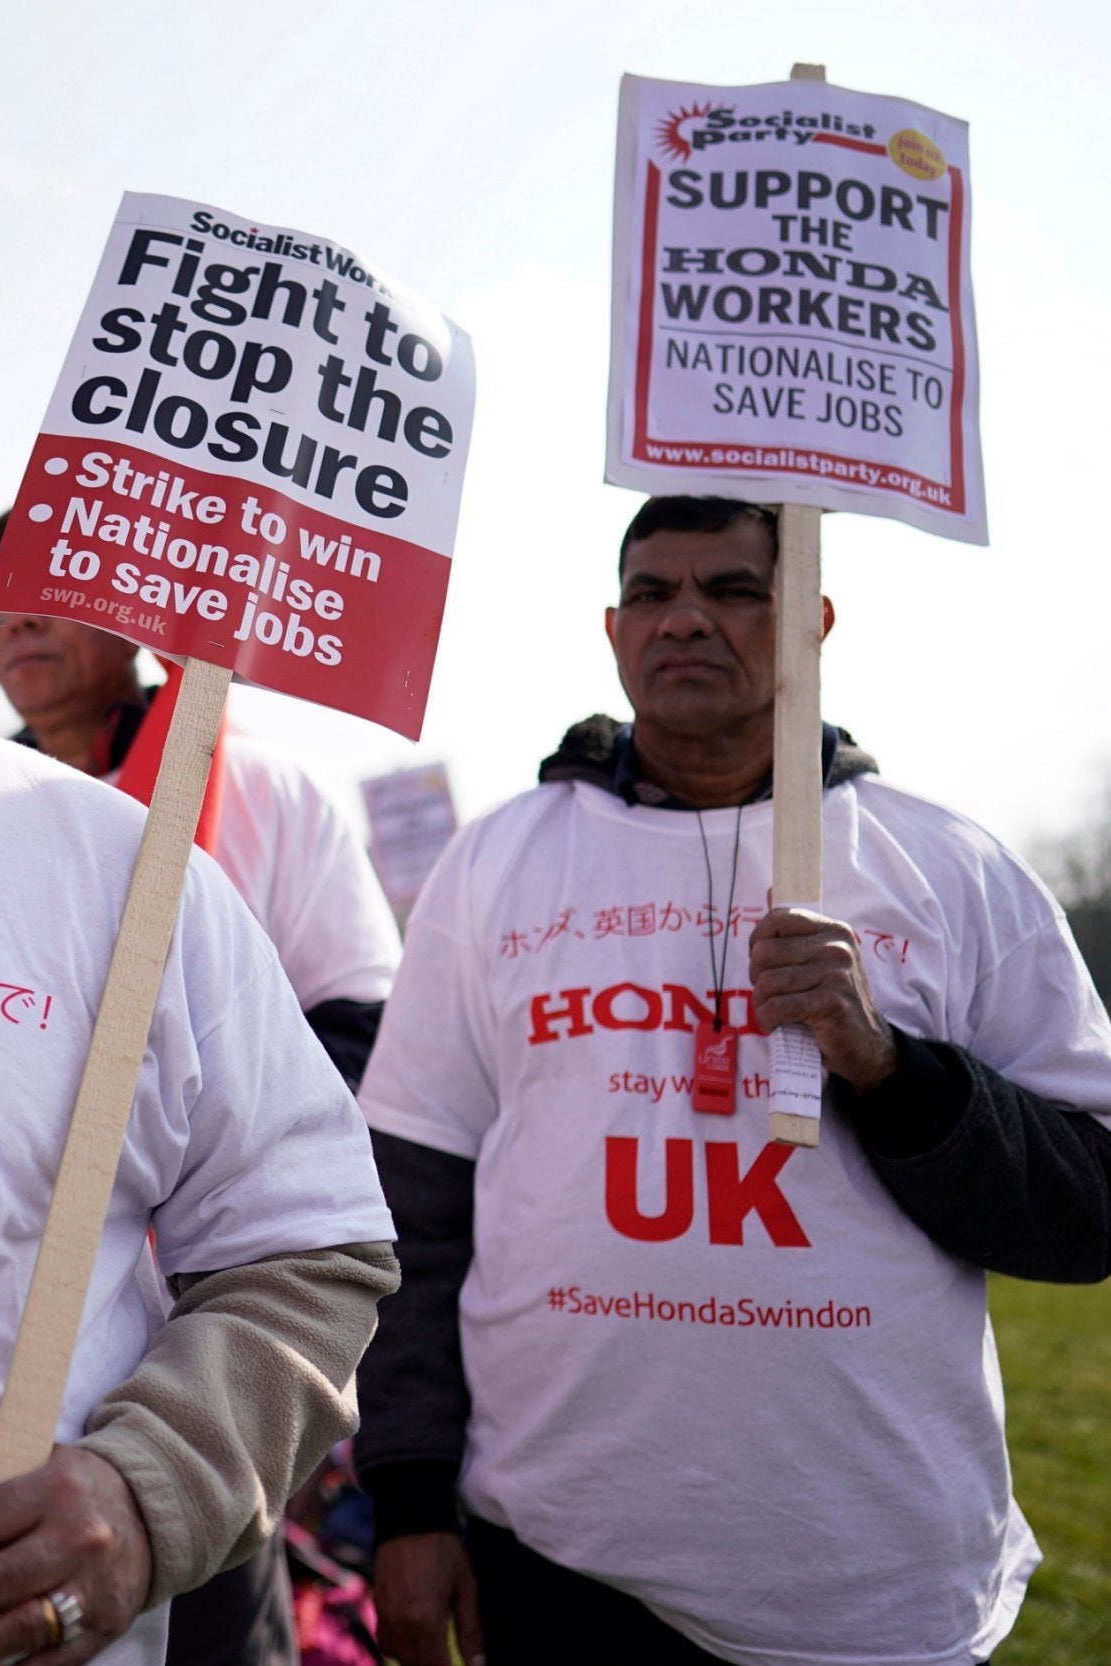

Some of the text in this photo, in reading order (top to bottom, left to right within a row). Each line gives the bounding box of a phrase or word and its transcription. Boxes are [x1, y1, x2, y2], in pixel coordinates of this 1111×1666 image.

[705, 109, 876, 139] Socialist
[899, 152, 938, 178] today
[666, 169, 949, 241] SUPPORT
[772, 214, 853, 252] THE
[191, 211, 396, 301] Socialist Wor
[663, 246, 949, 312] HONDA
[117, 229, 444, 383] Fight to
[661, 282, 937, 353] WORKERS
[92, 306, 454, 460] stop the
[666, 339, 944, 411] NATIONALISE TO
[713, 383, 904, 437] SAVE JOBS
[71, 368, 410, 518] closure
[646, 443, 952, 507] www.socialistparty.org.uk
[75, 451, 383, 583] Strike to win
[60, 497, 345, 622] Nationalise
[40, 584, 167, 636] swp.org.uk
[50, 541, 343, 667] to save jobs
[528, 982, 770, 1046] HON
[608, 1071, 666, 1104] stay
[742, 1073, 770, 1099] th
[605, 1137, 812, 1248] UK
[548, 1287, 871, 1329] #SaveHondaSwindon
